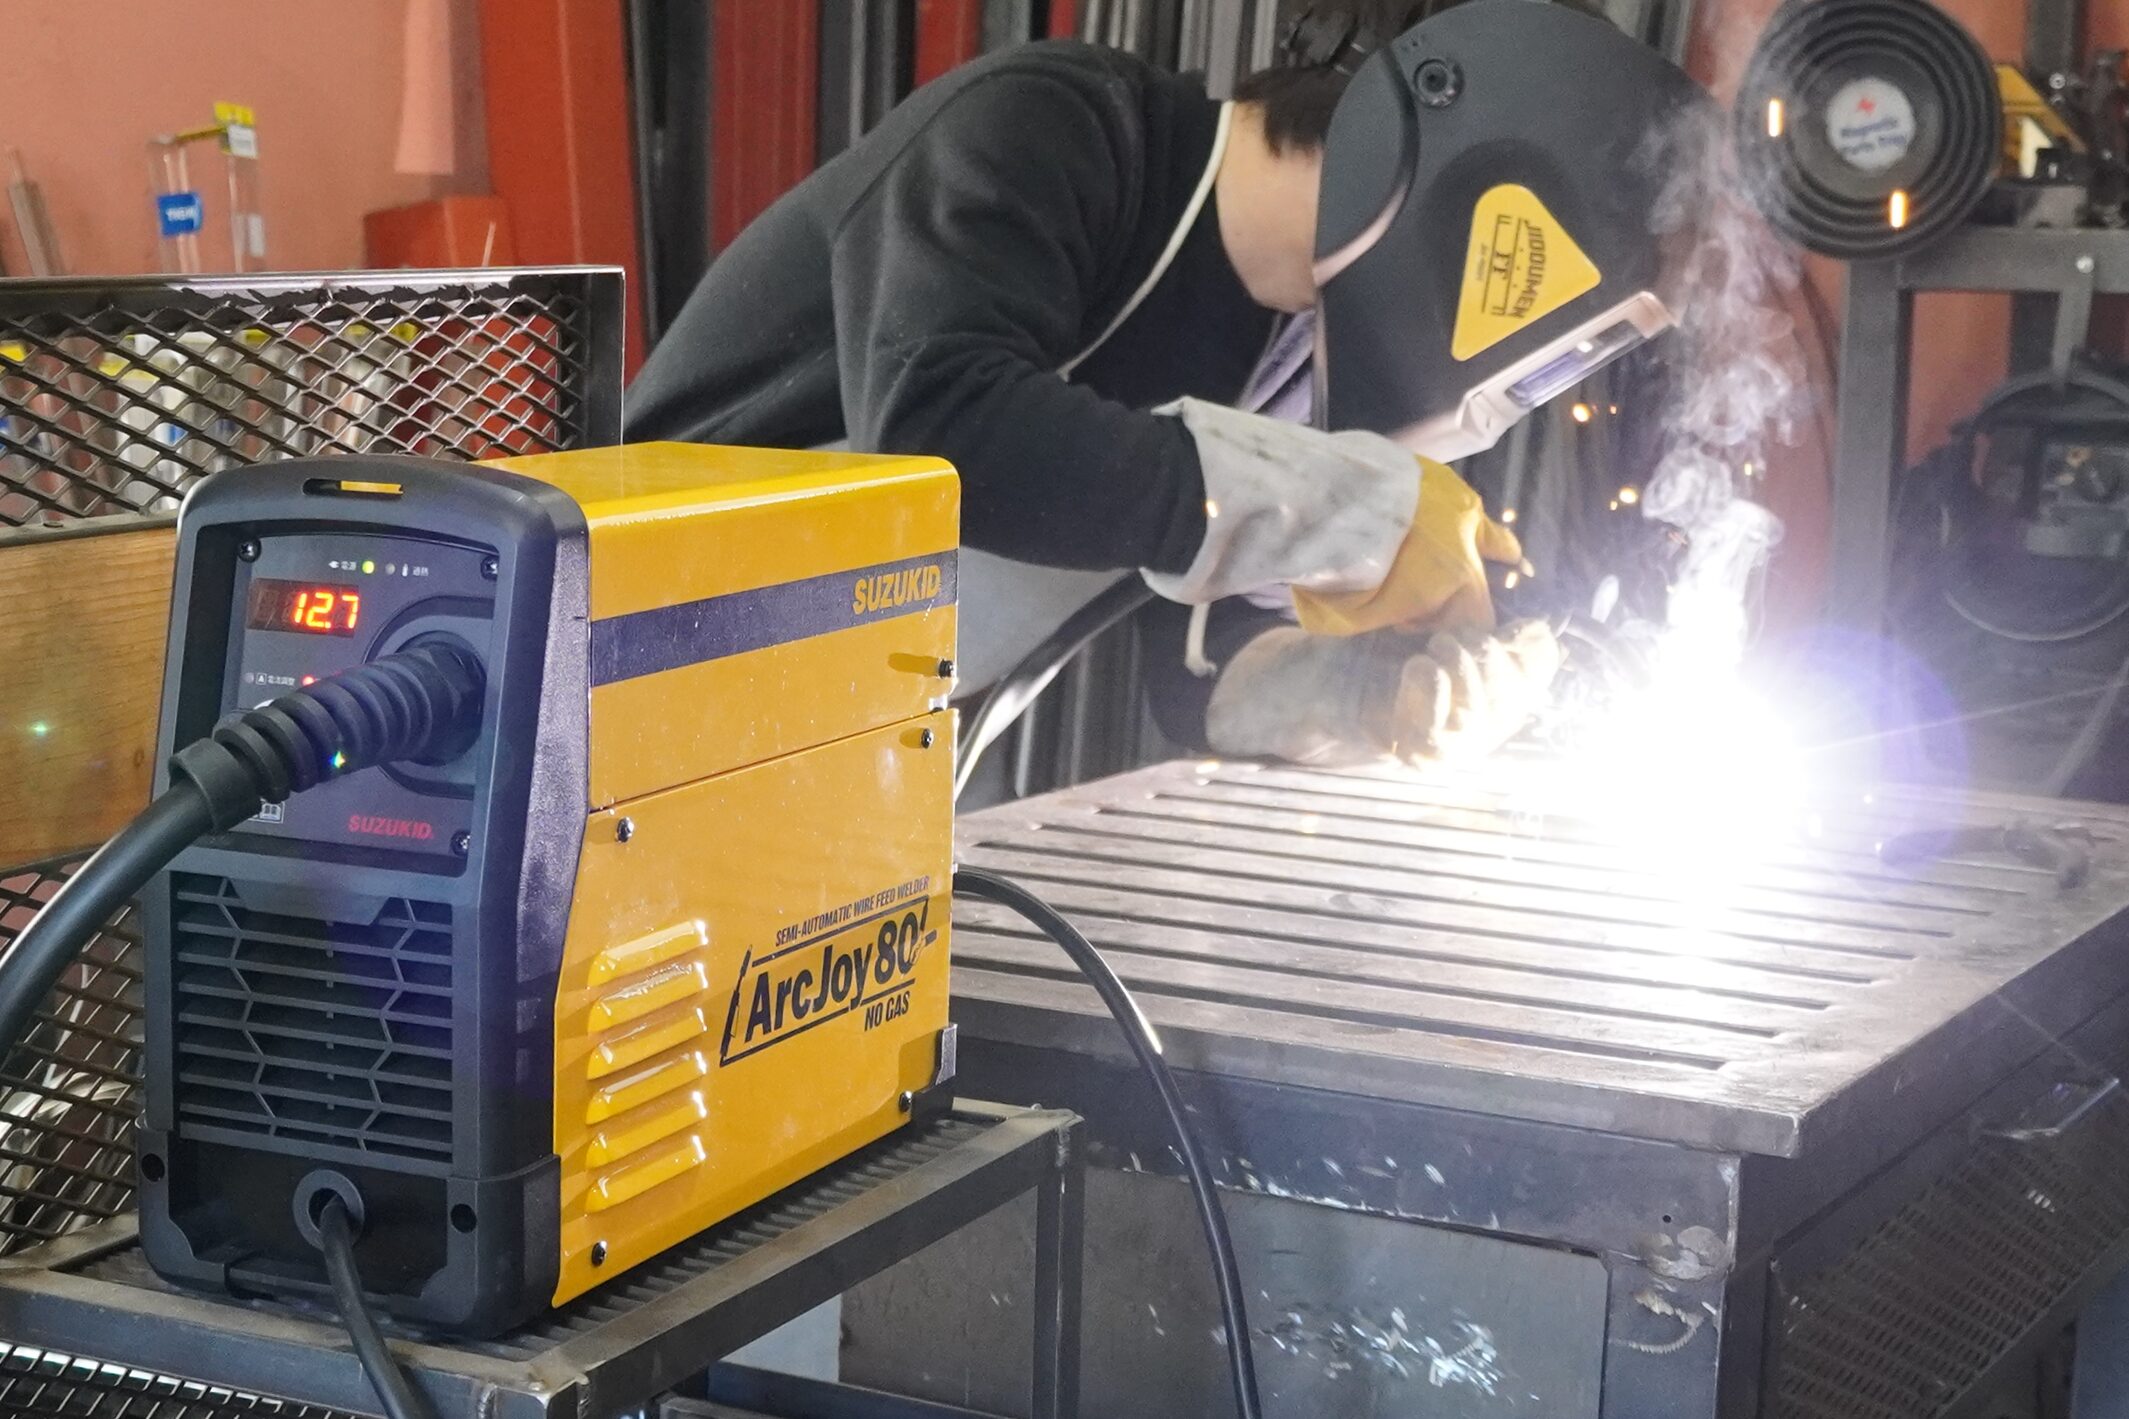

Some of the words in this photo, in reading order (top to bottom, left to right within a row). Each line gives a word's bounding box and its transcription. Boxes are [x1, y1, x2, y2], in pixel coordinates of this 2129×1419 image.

[294, 592, 360, 630] 12.7
[852, 564, 942, 616] SUZUKID
[347, 814, 434, 840] SUZUKID
[776, 903, 852, 947] SEMI-AUTOMATIC
[853, 894, 875, 917] WIRE
[876, 887, 896, 909] FEED
[897, 875, 930, 900] WELDER
[864, 1003, 883, 1032] NO
[885, 990, 911, 1022] GAS
